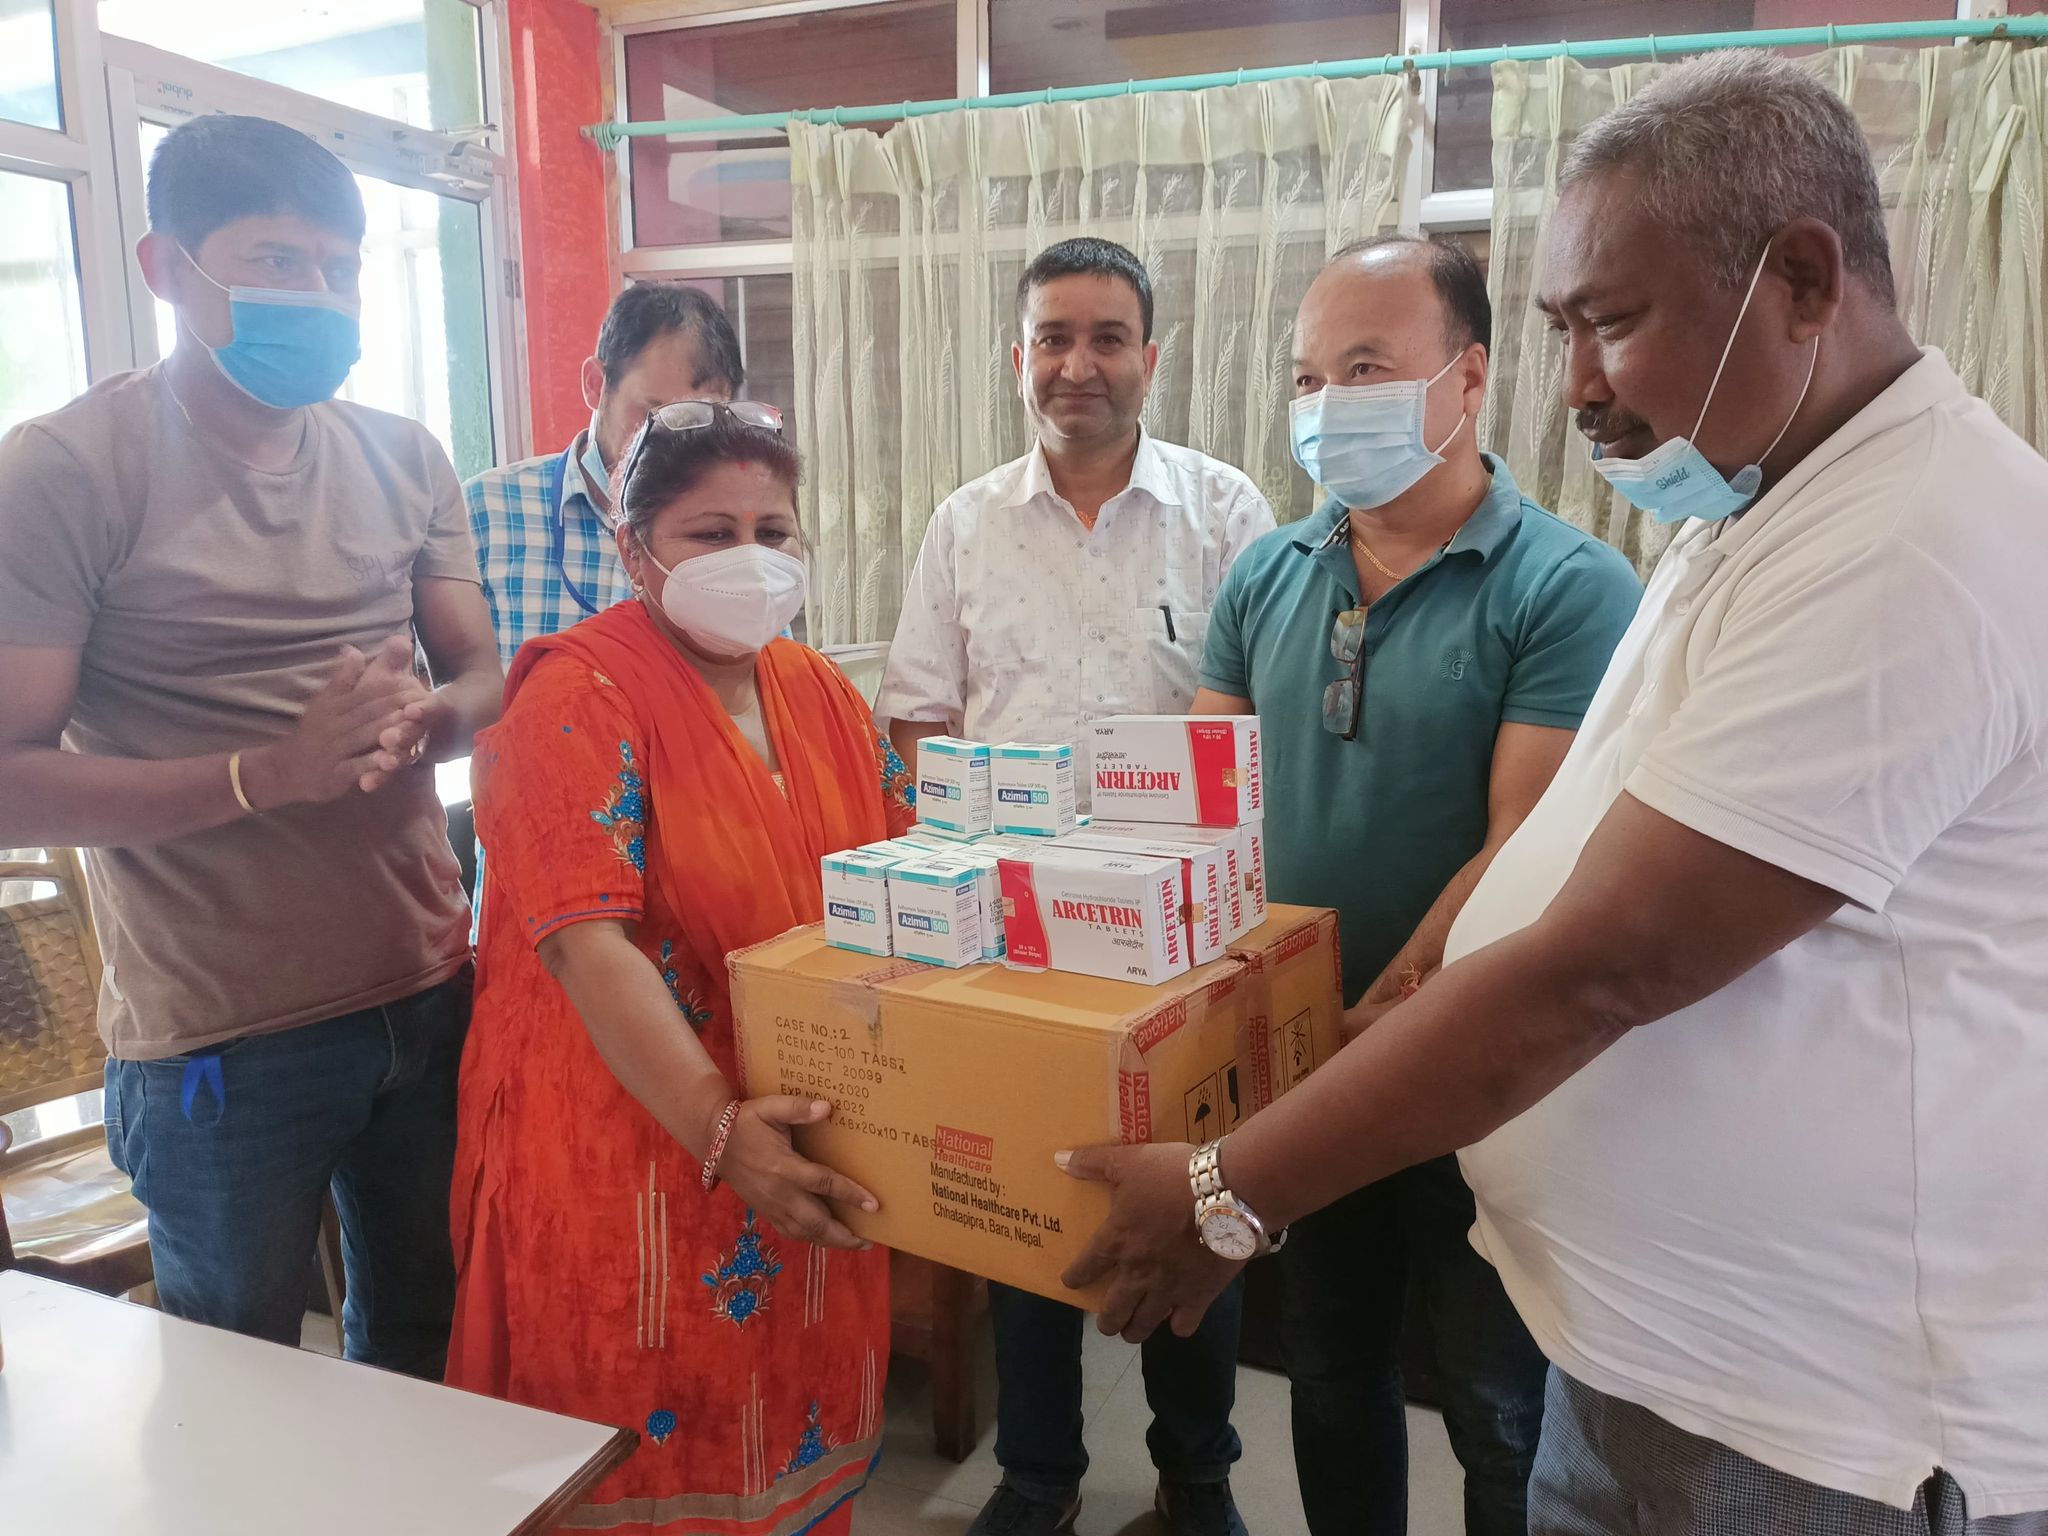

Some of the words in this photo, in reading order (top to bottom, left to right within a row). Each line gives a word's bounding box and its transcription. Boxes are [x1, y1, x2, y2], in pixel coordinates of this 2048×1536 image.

[1656, 467, 1690, 490] Shield
[1096, 770, 1180, 791] ARCETRIN
[1249, 730, 1261, 810] ARCETRIN
[923, 782, 945, 796] Azimin
[947, 788, 960, 800] 500
[1002, 790, 1028, 802] Azimin
[1032, 792, 1048, 803] 500
[1227, 849, 1242, 930] ARCETRIN
[1251, 836, 1264, 916] ARCETRIN
[832, 904, 857, 920] Azimin
[860, 910, 874, 922] 500
[1052, 899, 1143, 929] ARCETRIN
[1206, 864, 1220, 948] ARCETRIN
[902, 914, 930, 930] Azimin
[932, 920, 948, 932] 500
[1088, 923, 1144, 938] TABLETS
[1161, 878, 1179, 965] ARCETRIN
[1275, 927, 1318, 963] National
[1126, 966, 1148, 977] ARYA
[776, 1016, 804, 1032] CASE
[776, 1034, 854, 1060] ACENAC-100
[778, 1050, 832, 1072] B.NO.ACT
[1134, 1074, 1149, 1141] Natio
[937, 1128, 992, 1159] National
[934, 1150, 992, 1174] Healthcare
[930, 1162, 988, 1191] Manufactured
[932, 1182, 968, 1206] National
[970, 1194, 1020, 1220] Healthcare
[1022, 1208, 1042, 1228] Pvt.
[1044, 1214, 1063, 1234] Ltd.
[933, 1202, 987, 1232] Chhatapipra,
[988, 1218, 1013, 1240] Bara,
[1014, 1226, 1044, 1248] Nepal.
